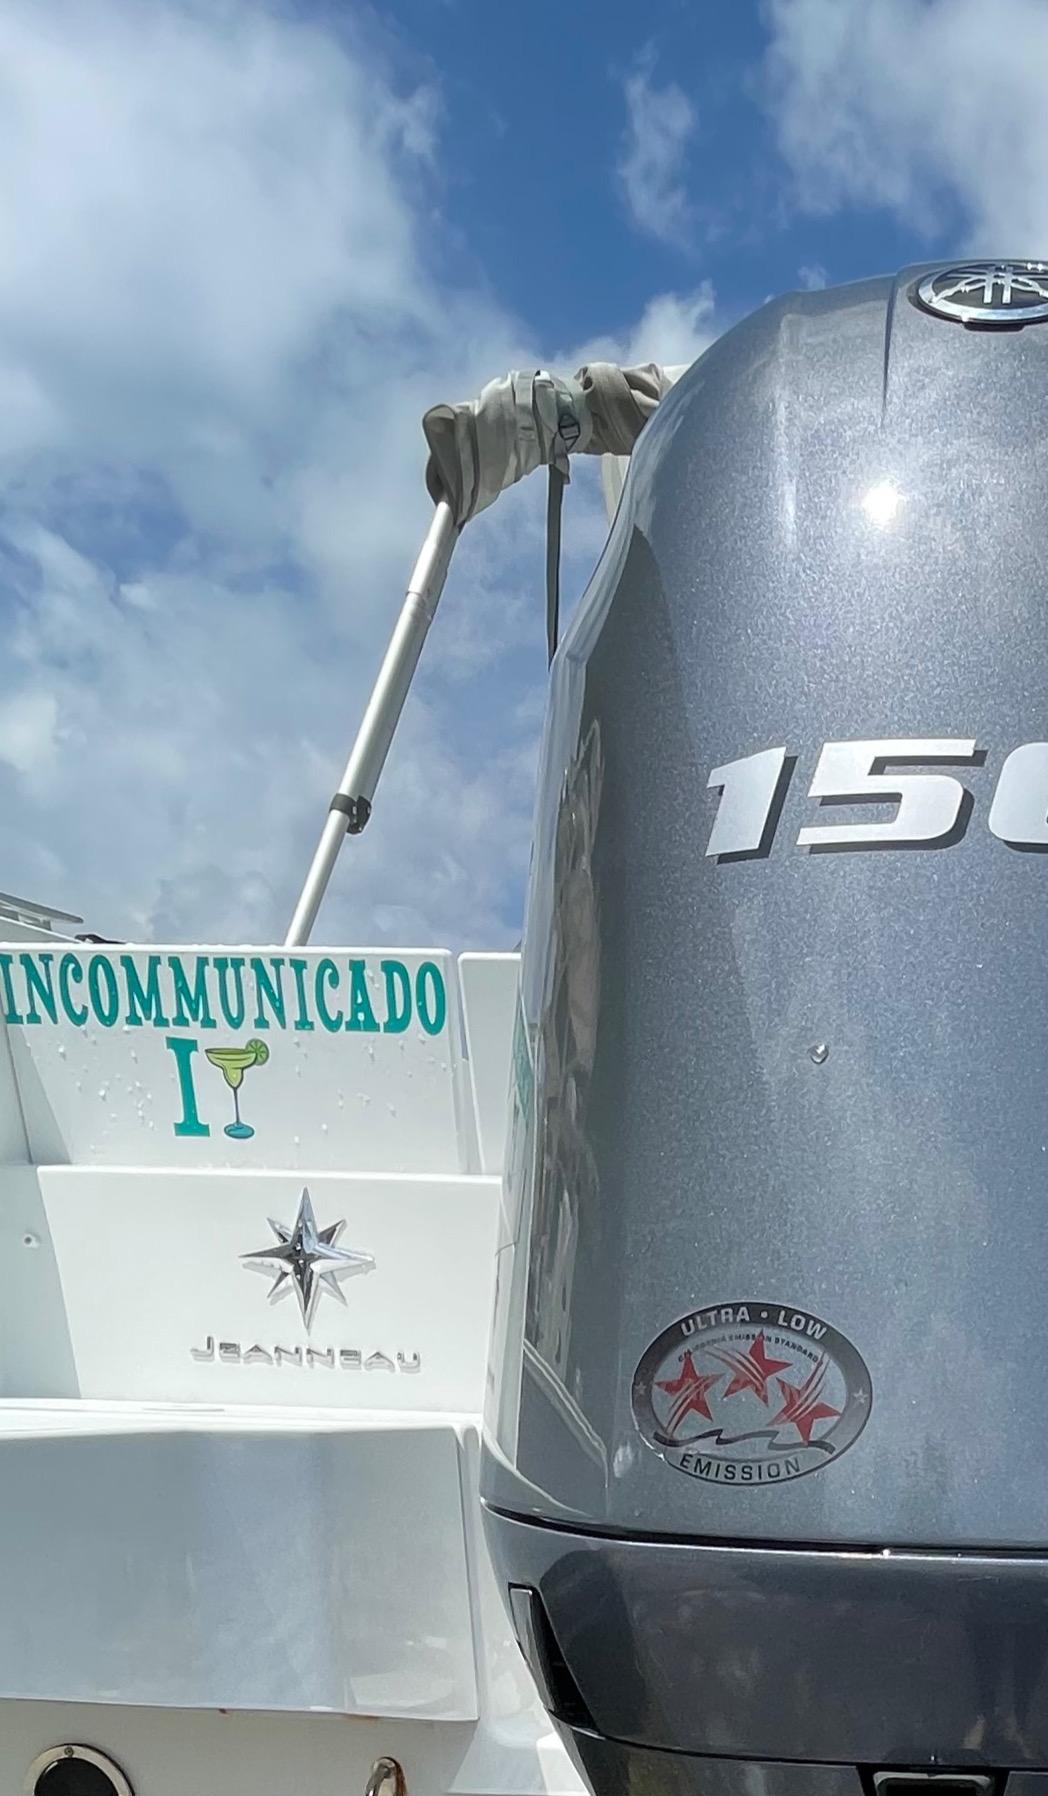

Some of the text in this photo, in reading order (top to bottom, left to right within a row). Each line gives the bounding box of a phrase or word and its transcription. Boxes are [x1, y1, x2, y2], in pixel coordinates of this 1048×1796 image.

[0, 953, 447, 1036] INCOMMUNICADO
[166, 1036, 210, 1137] I
[680, 1306, 828, 1340] ULTRA LOW
[190, 1336, 421, 1373] JEANNEAU
[679, 1453, 801, 1481] EMISSION
